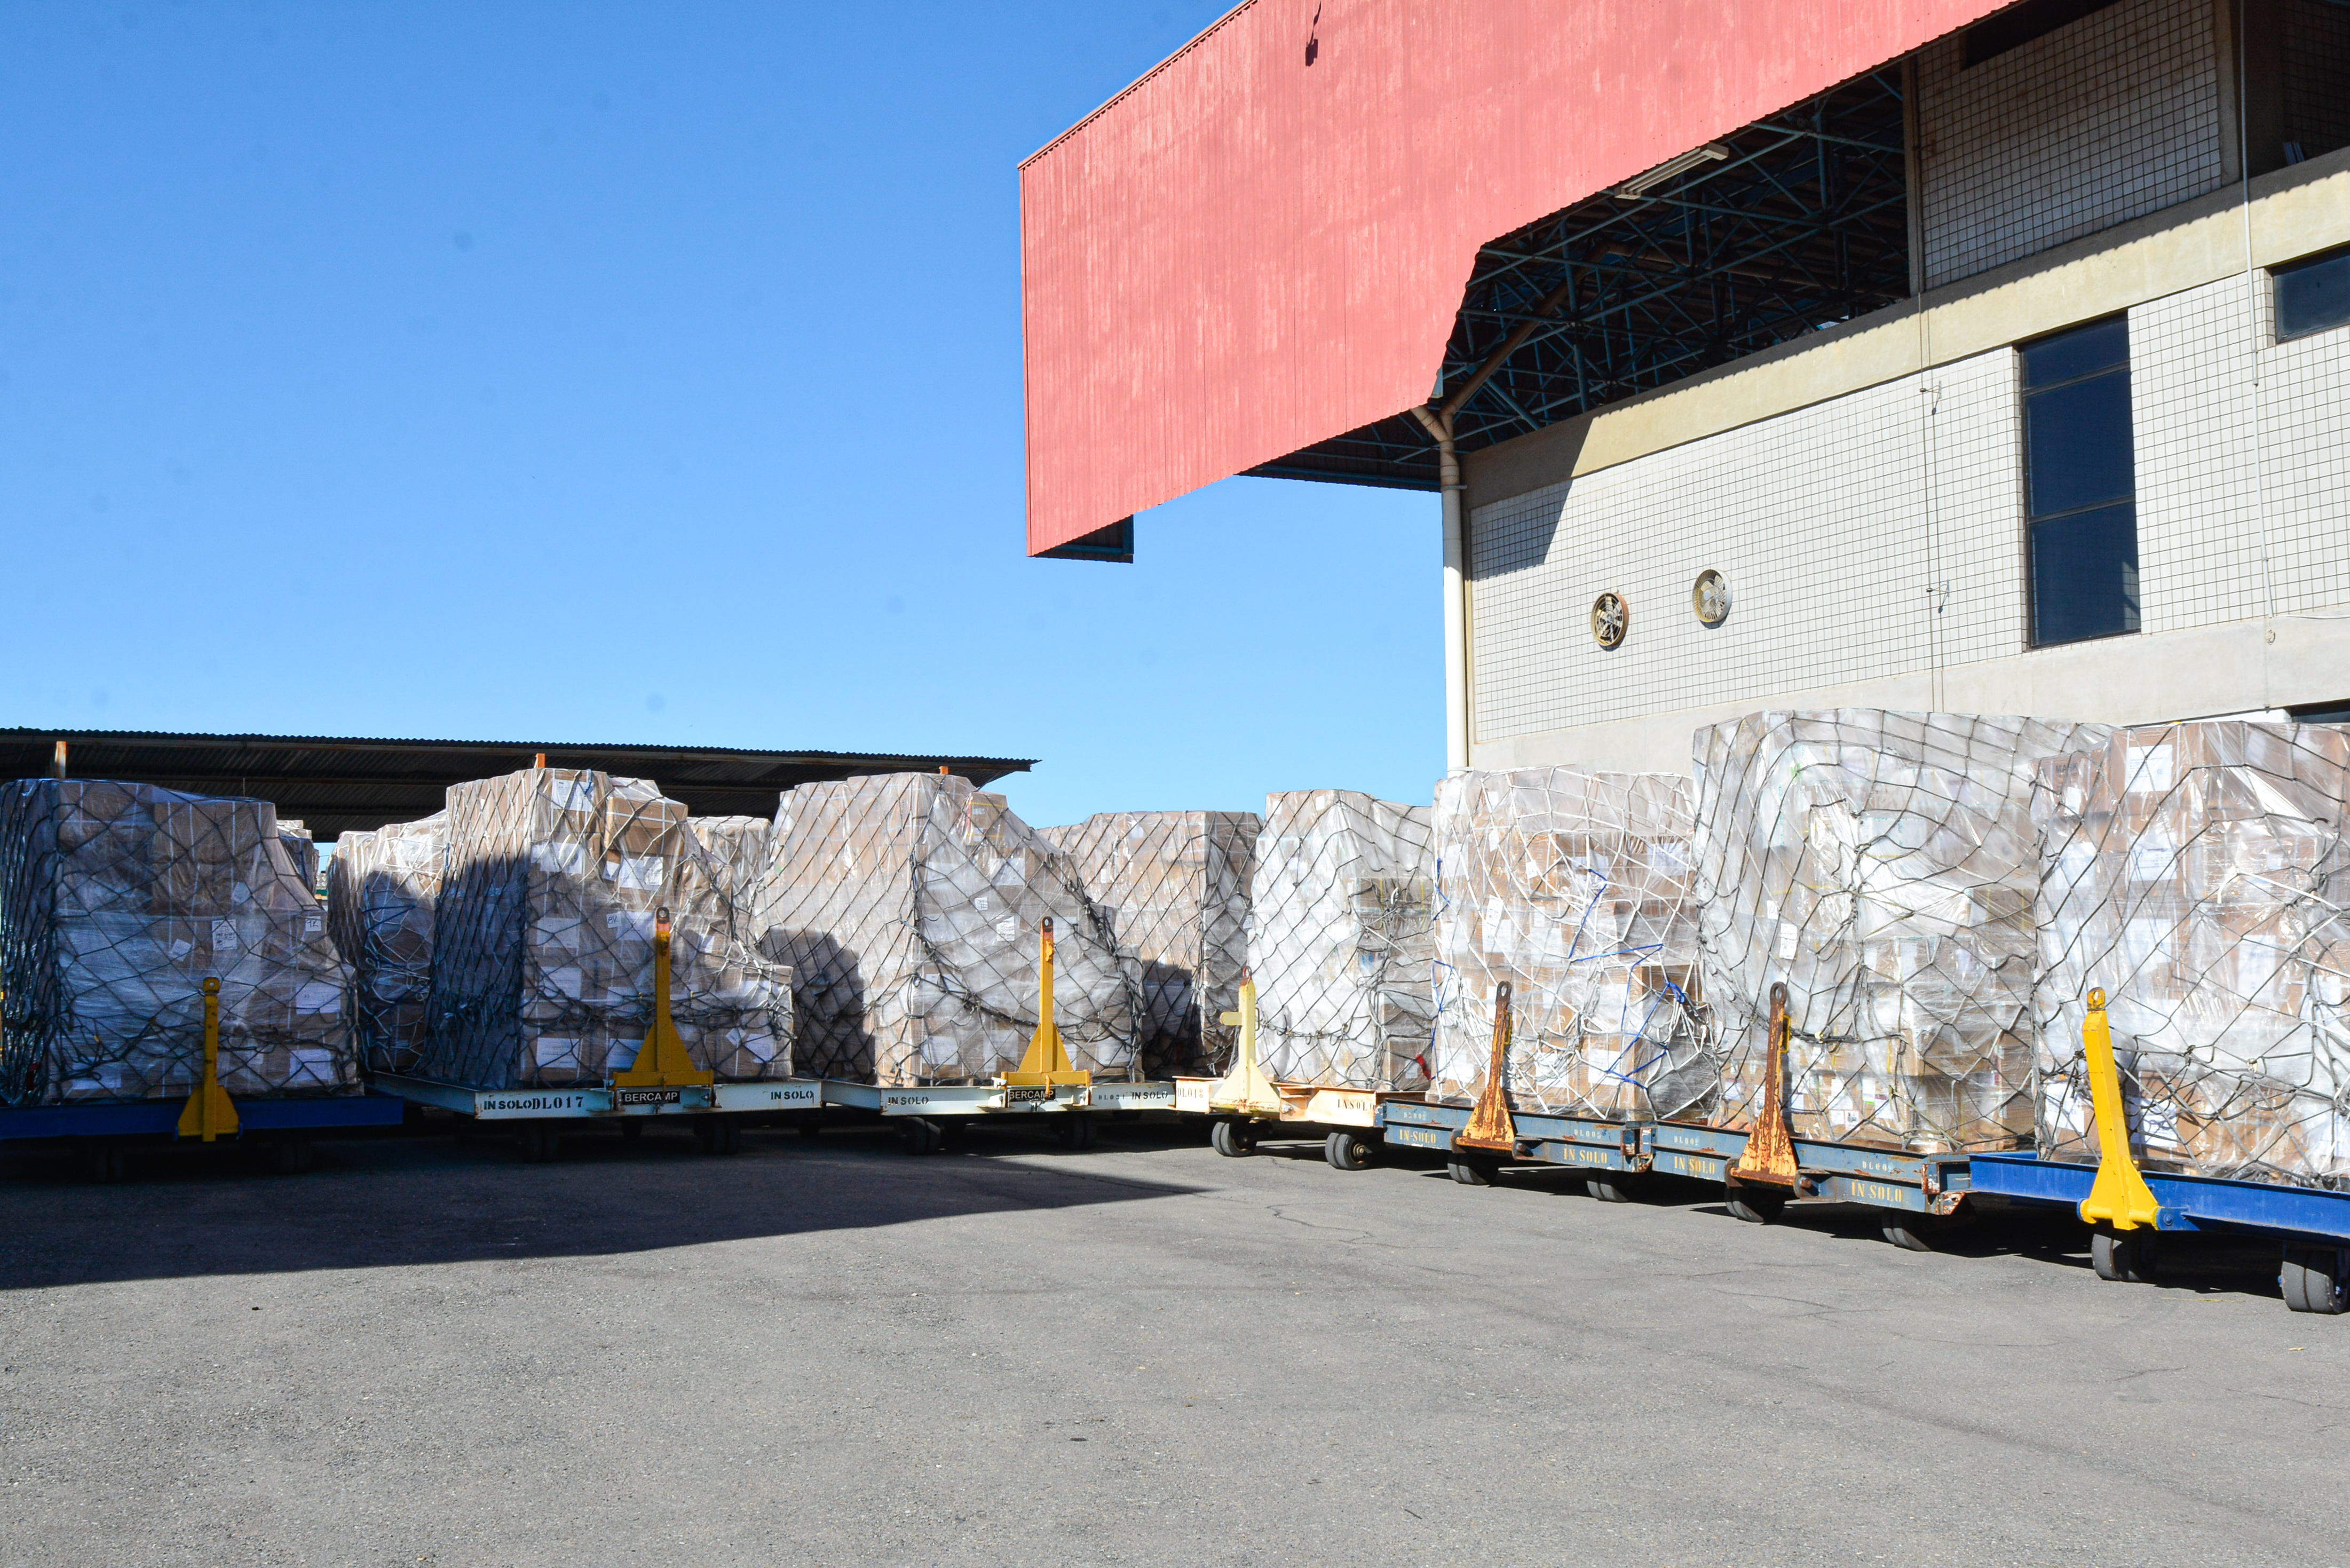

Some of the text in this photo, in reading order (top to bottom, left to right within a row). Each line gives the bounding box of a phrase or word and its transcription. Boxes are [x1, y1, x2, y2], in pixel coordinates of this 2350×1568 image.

[624, 1092, 678, 1102] BERCAMP
[771, 1090, 814, 1100] IN SOLO
[1010, 1090, 1054, 1099] BERCAMP
[1132, 1091, 1168, 1100] IN SOLO
[484, 1099, 532, 1110] IN SOLO
[532, 1096, 584, 1110] DL017
[888, 1096, 929, 1106] IN SOLO
[1564, 1148, 1608, 1163] IN SOLO
[1674, 1156, 1715, 1175] IN SOLO
[1851, 1182, 1903, 1202] IN SOLO
